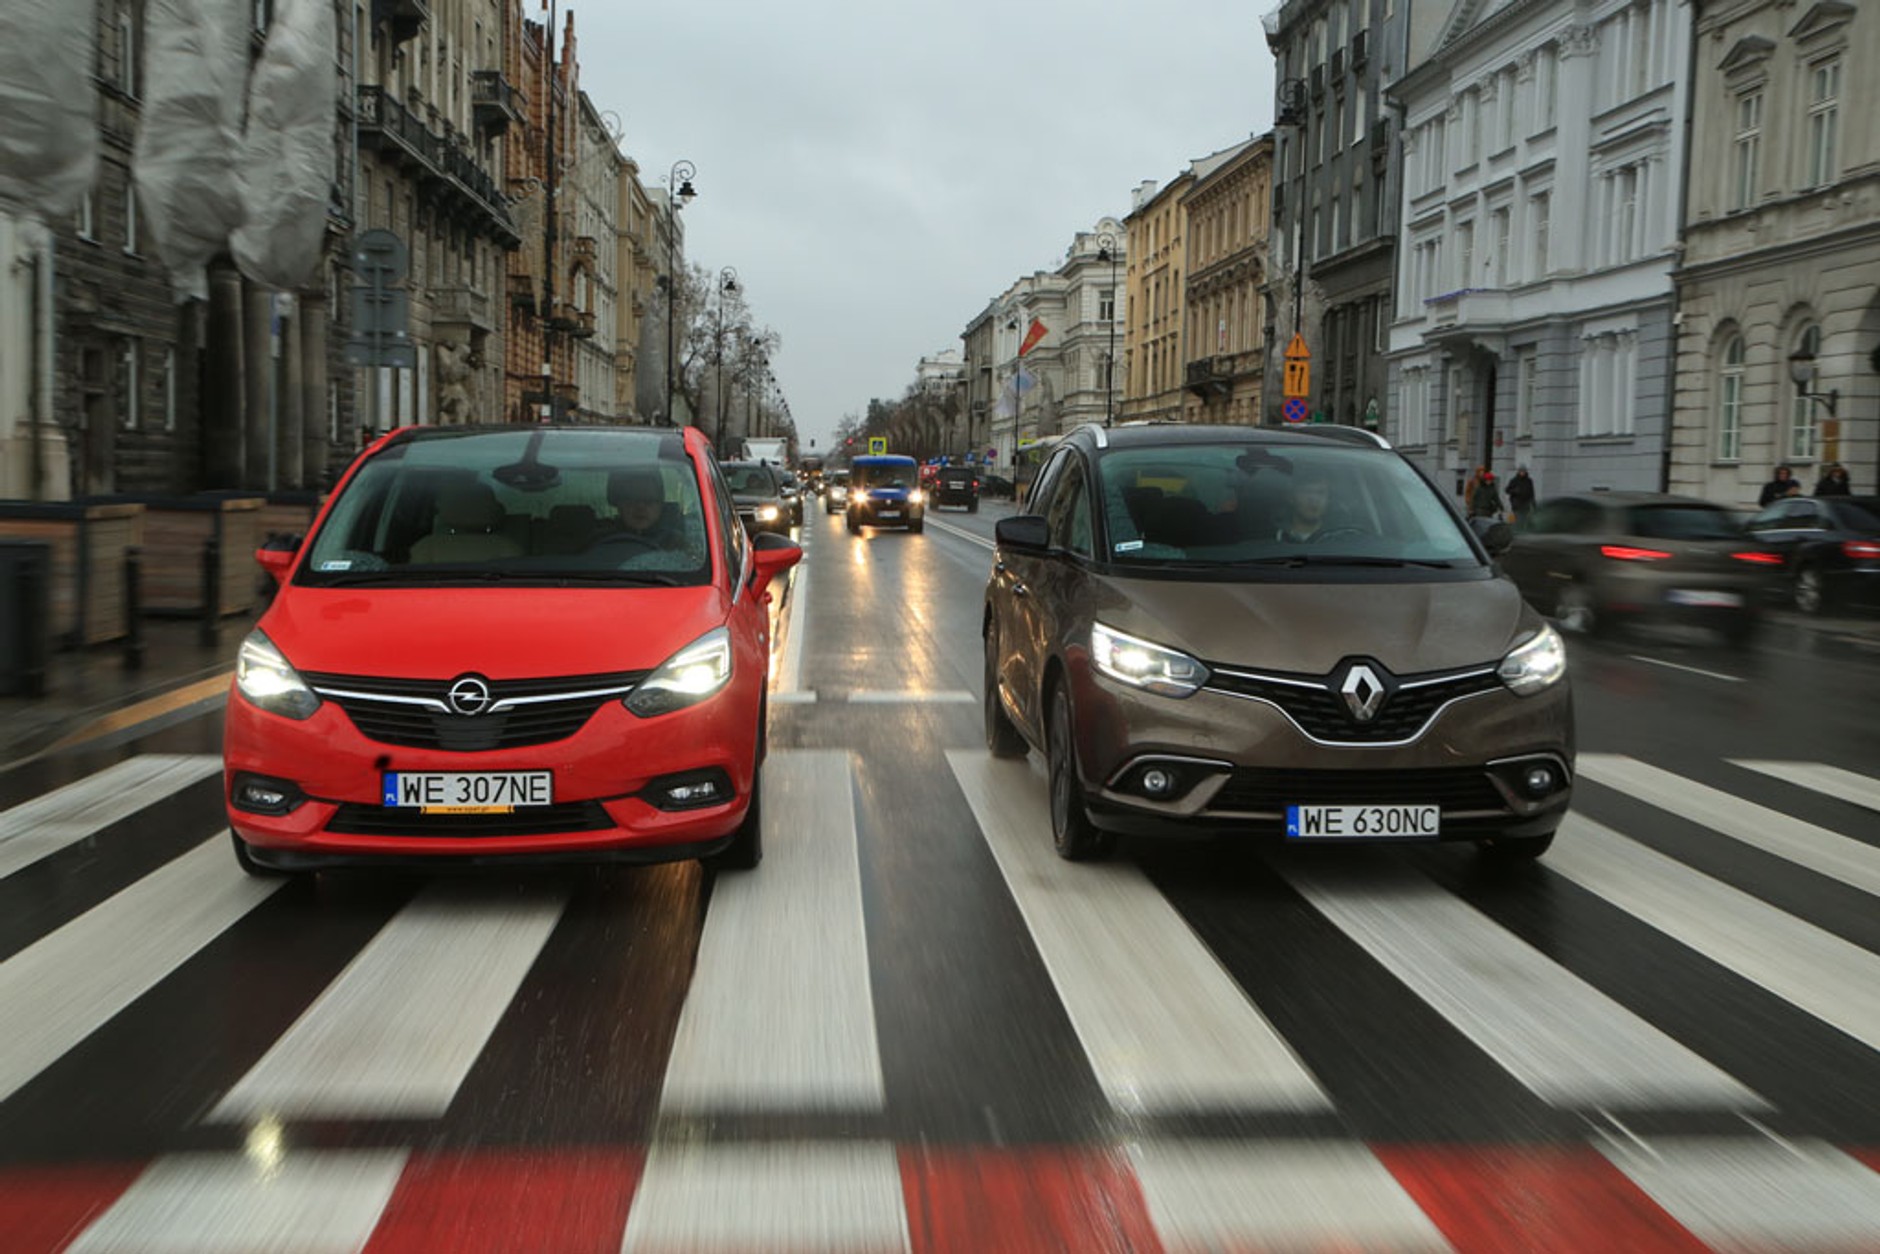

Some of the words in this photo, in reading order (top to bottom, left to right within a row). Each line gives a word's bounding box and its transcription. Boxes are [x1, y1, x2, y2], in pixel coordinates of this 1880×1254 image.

[403, 776, 444, 803] WE
[456, 775, 546, 803] 307NE
[1304, 808, 1343, 834] WE
[1353, 808, 1436, 833] 630NC
